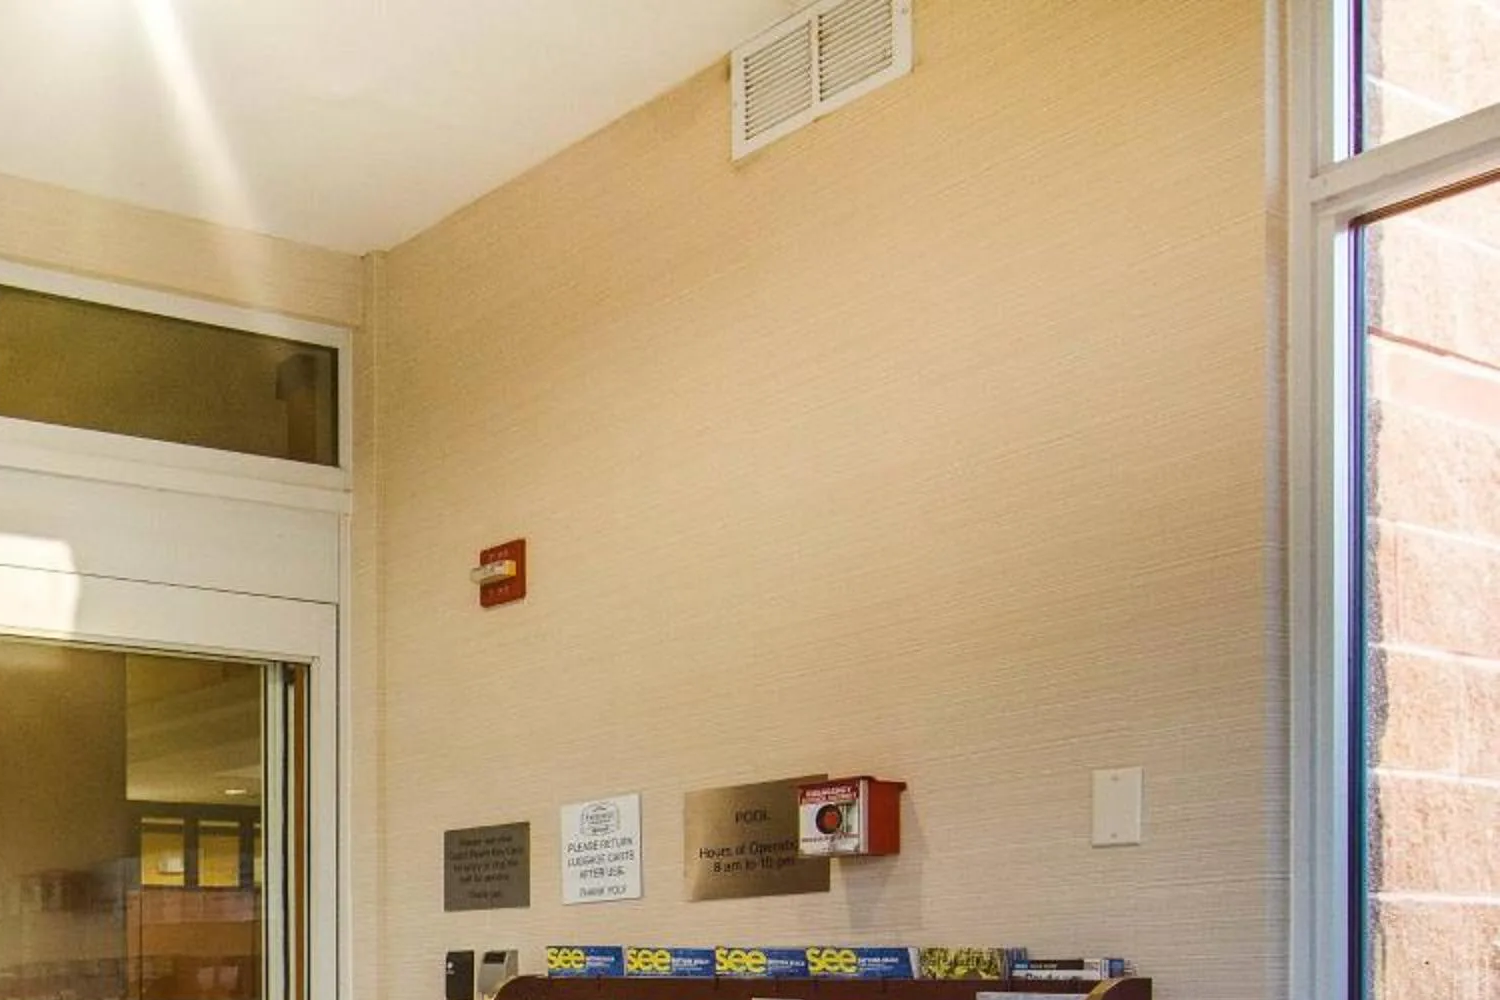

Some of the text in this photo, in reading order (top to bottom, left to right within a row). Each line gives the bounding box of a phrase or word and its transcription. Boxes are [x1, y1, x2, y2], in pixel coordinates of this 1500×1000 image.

[735, 809, 771, 824] POOL
[547, 947, 586, 970] see
[627, 948, 672, 972] see
[715, 946, 768, 973] see
[806, 946, 858, 973] see
